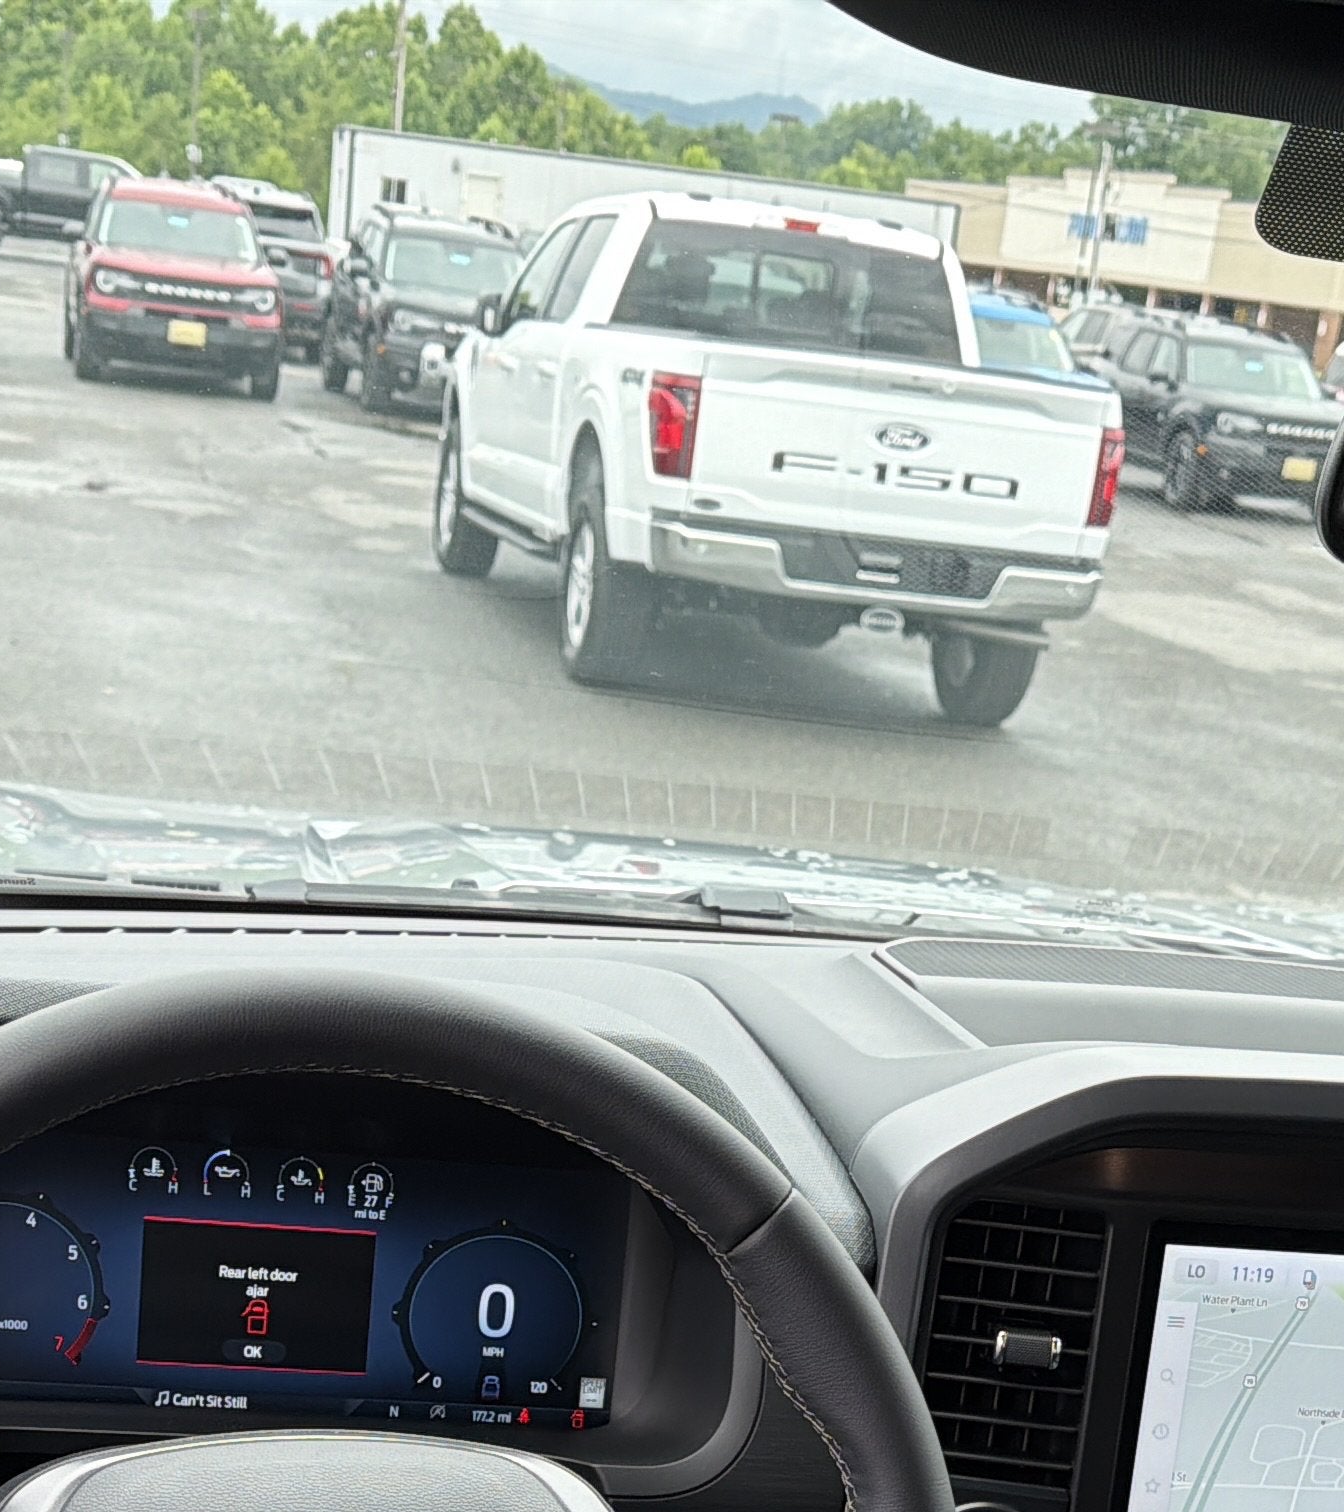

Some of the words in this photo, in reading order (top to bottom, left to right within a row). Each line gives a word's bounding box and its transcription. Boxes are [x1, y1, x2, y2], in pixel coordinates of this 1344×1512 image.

[772, 450, 1019, 500] F-150
[128, 1178, 138, 1191] C
[168, 1182, 178, 1194] H
[241, 1185, 251, 1198] H
[314, 1192, 325, 1204] H
[364, 1196, 377, 1208] 27
[26, 1212, 37, 1228] 4
[355, 1209, 368, 1219] mi
[369, 1210, 379, 1219] to
[379, 1210, 386, 1220] E
[68, 1245, 78, 1261] 5
[219, 1264, 246, 1280] Rear
[248, 1267, 268, 1281] left
[270, 1267, 298, 1282] door
[1187, 1264, 1206, 1279] LO
[1233, 1266, 1274, 1283] 11:19
[246, 1284, 269, 1299] ajar
[77, 1294, 88, 1310] 6
[1202, 1294, 1229, 1306] Water
[1231, 1296, 1255, 1307] Plant
[1256, 1297, 1268, 1307] Ln
[478, 1283, 515, 1338] 0
[54, 1336, 64, 1351] 7
[243, 1345, 262, 1359] OK
[482, 1346, 504, 1358] MPH
[432, 1376, 442, 1388] 0
[530, 1381, 548, 1394] 120
[172, 1393, 204, 1408] Can't
[206, 1394, 222, 1408] Sit
[224, 1395, 248, 1409] Still
[389, 1405, 399, 1418] N
[497, 1411, 512, 1423] mi
[1297, 1407, 1340, 1420] Northside
